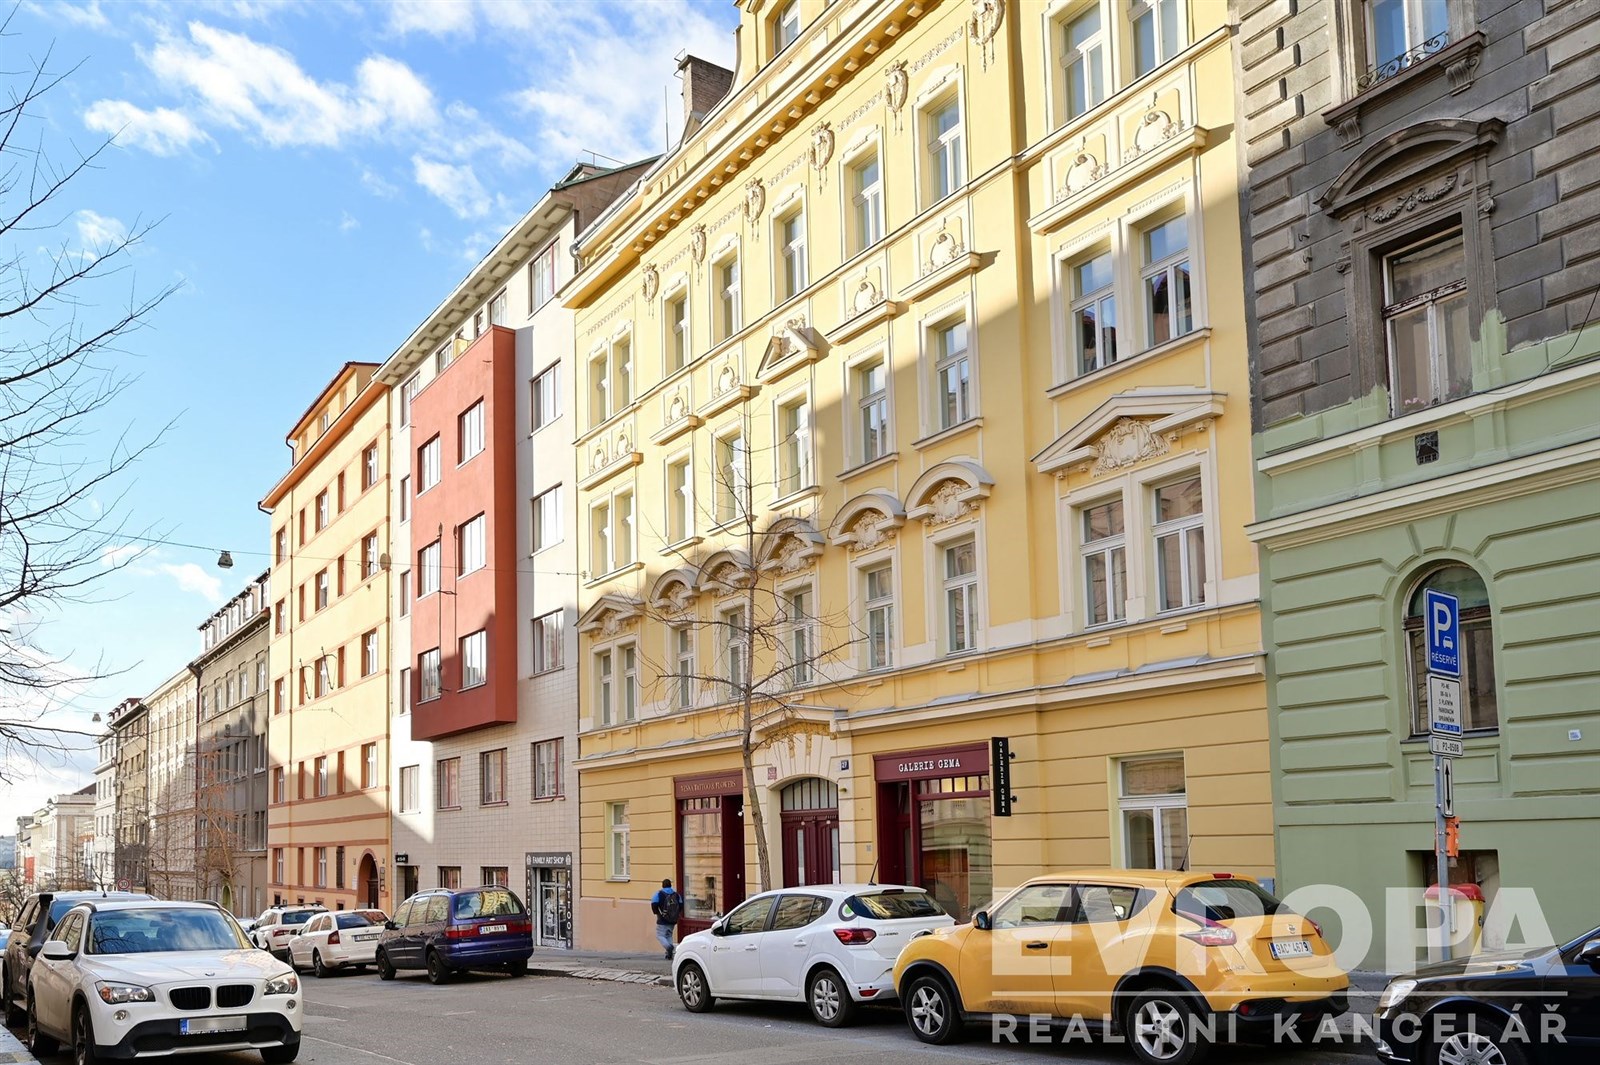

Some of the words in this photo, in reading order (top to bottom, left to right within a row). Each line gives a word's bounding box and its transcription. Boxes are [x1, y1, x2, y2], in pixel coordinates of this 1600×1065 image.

[1434, 602, 1452, 647] P
[1432, 650, 1457, 666] RÉSERVÉ
[898, 760, 935, 773] GALERIE
[938, 758, 961, 769] GEMA
[532, 856, 545, 864] FAMILY
[545, 856, 553, 864] ART
[553, 856, 564, 864] SHOP
[1276, 943, 1290, 954] 9AC
